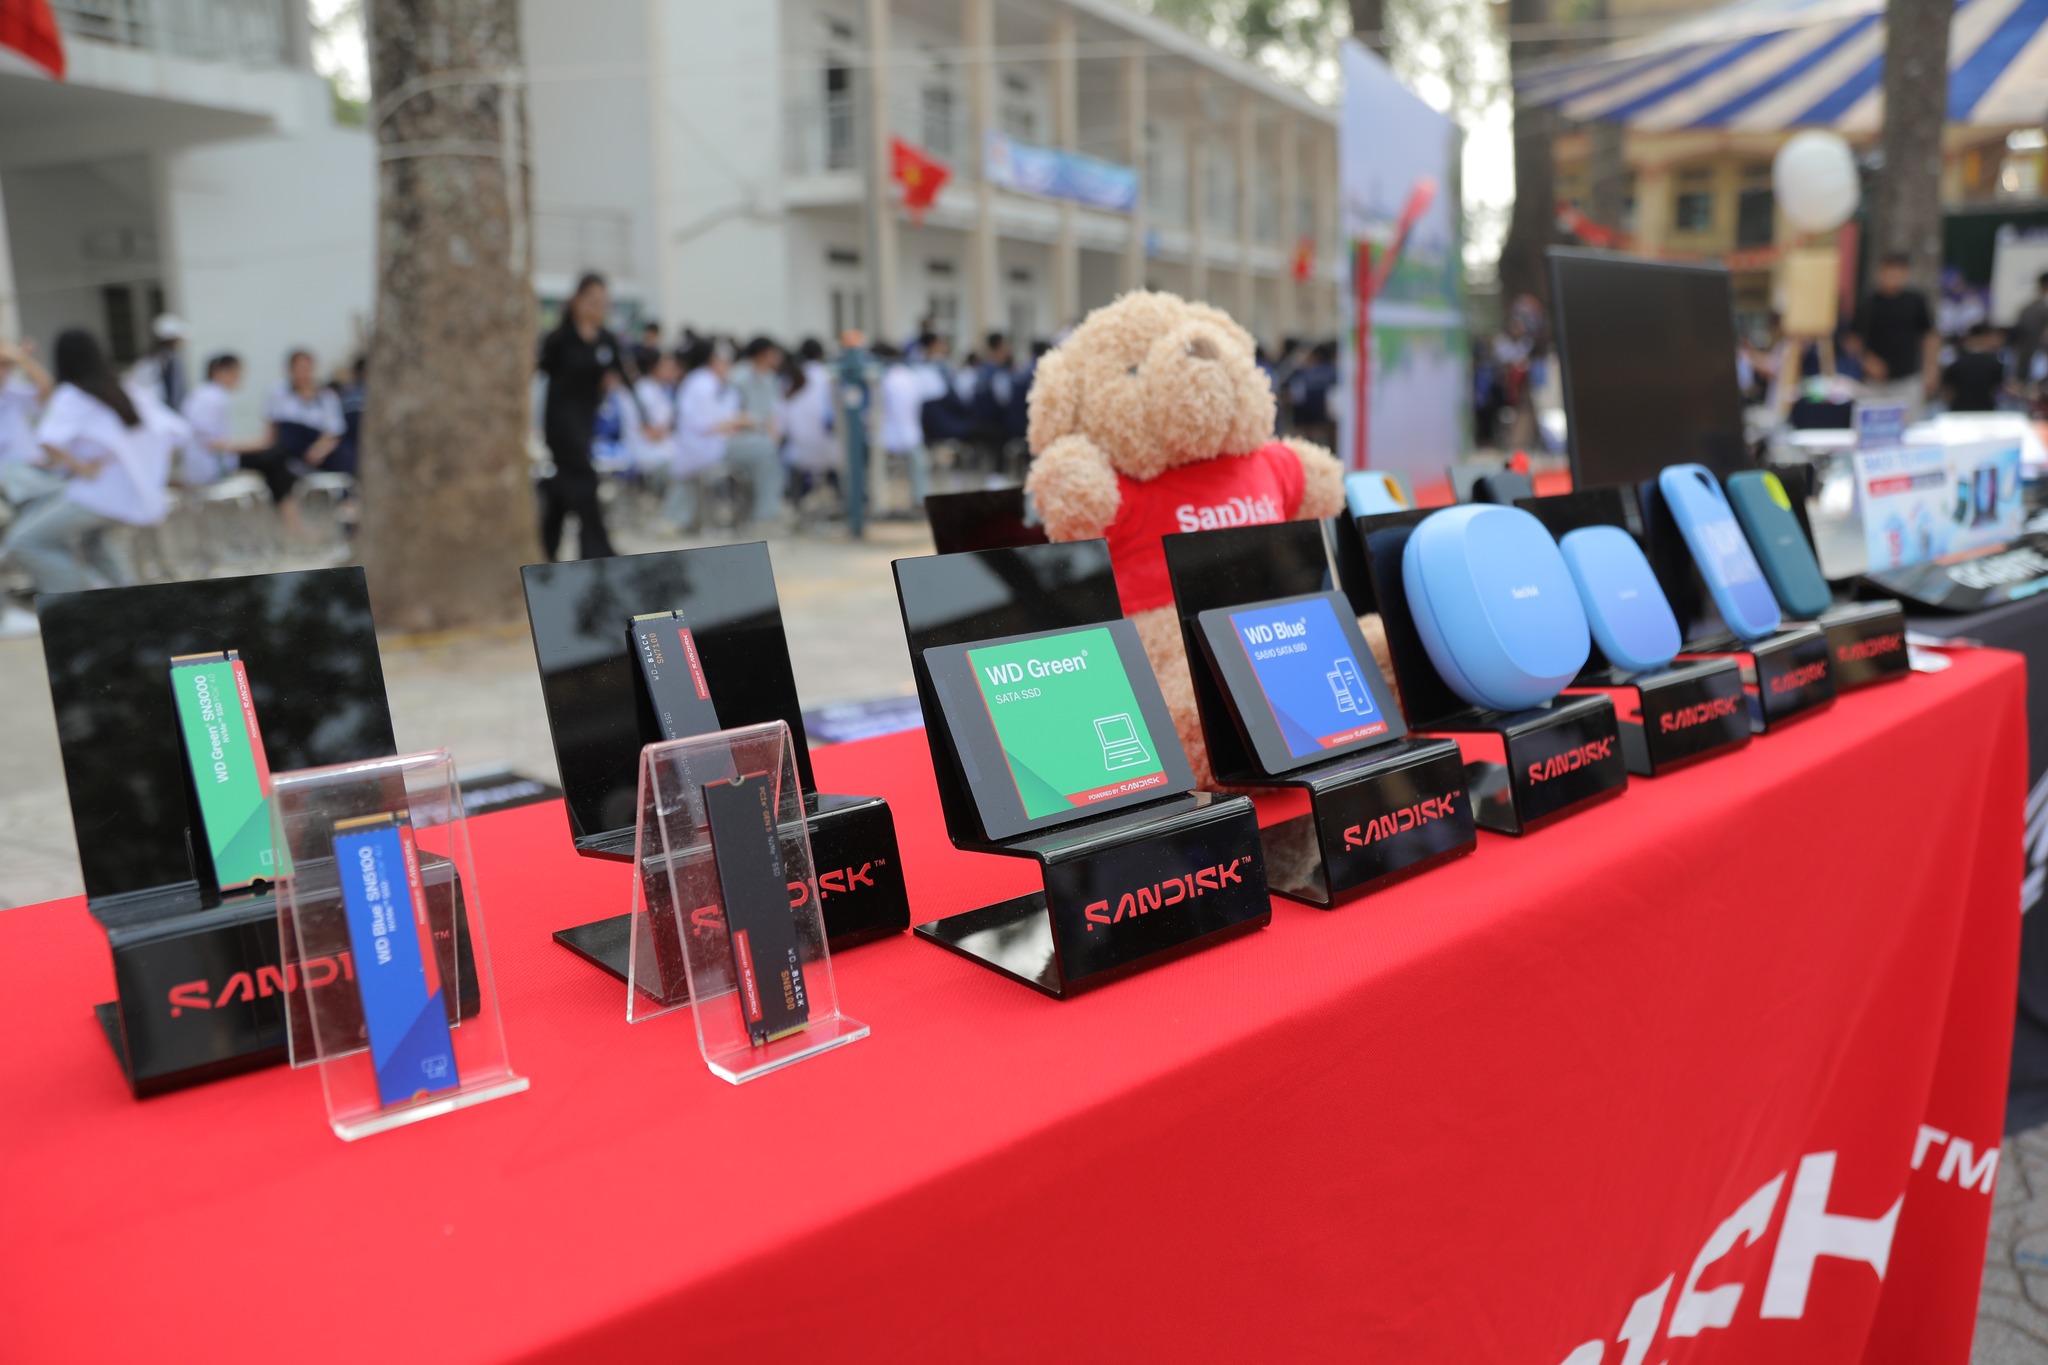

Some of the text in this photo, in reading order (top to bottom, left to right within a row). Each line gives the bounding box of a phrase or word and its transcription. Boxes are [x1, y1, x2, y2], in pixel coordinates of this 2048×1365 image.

[1176, 493, 1278, 533] SanDisk
[1244, 624, 1273, 645] WD
[638, 633, 660, 681] WD_BLACK
[649, 632, 664, 665] SN7100
[1254, 642, 1308, 661] SA510 SATA SSD
[985, 662, 1024, 686] WD
[194, 675, 215, 722] SN3000
[235, 670, 250, 709] SANDISK
[995, 687, 1041, 705] SATA SSD
[215, 703, 225, 717] SSD
[664, 711, 673, 725] SSD
[249, 714, 257, 739] POWERED
[215, 761, 229, 783] WD
[1088, 776, 1160, 800] POWERED BY SANDISK
[763, 810, 771, 829] GEN
[771, 862, 781, 878] SSD
[359, 845, 381, 902] SN5100
[379, 881, 391, 900] SSD
[374, 936, 392, 965] WD
[780, 970, 796, 1011] SN8100
[787, 948, 805, 1008] WD_BLACK
